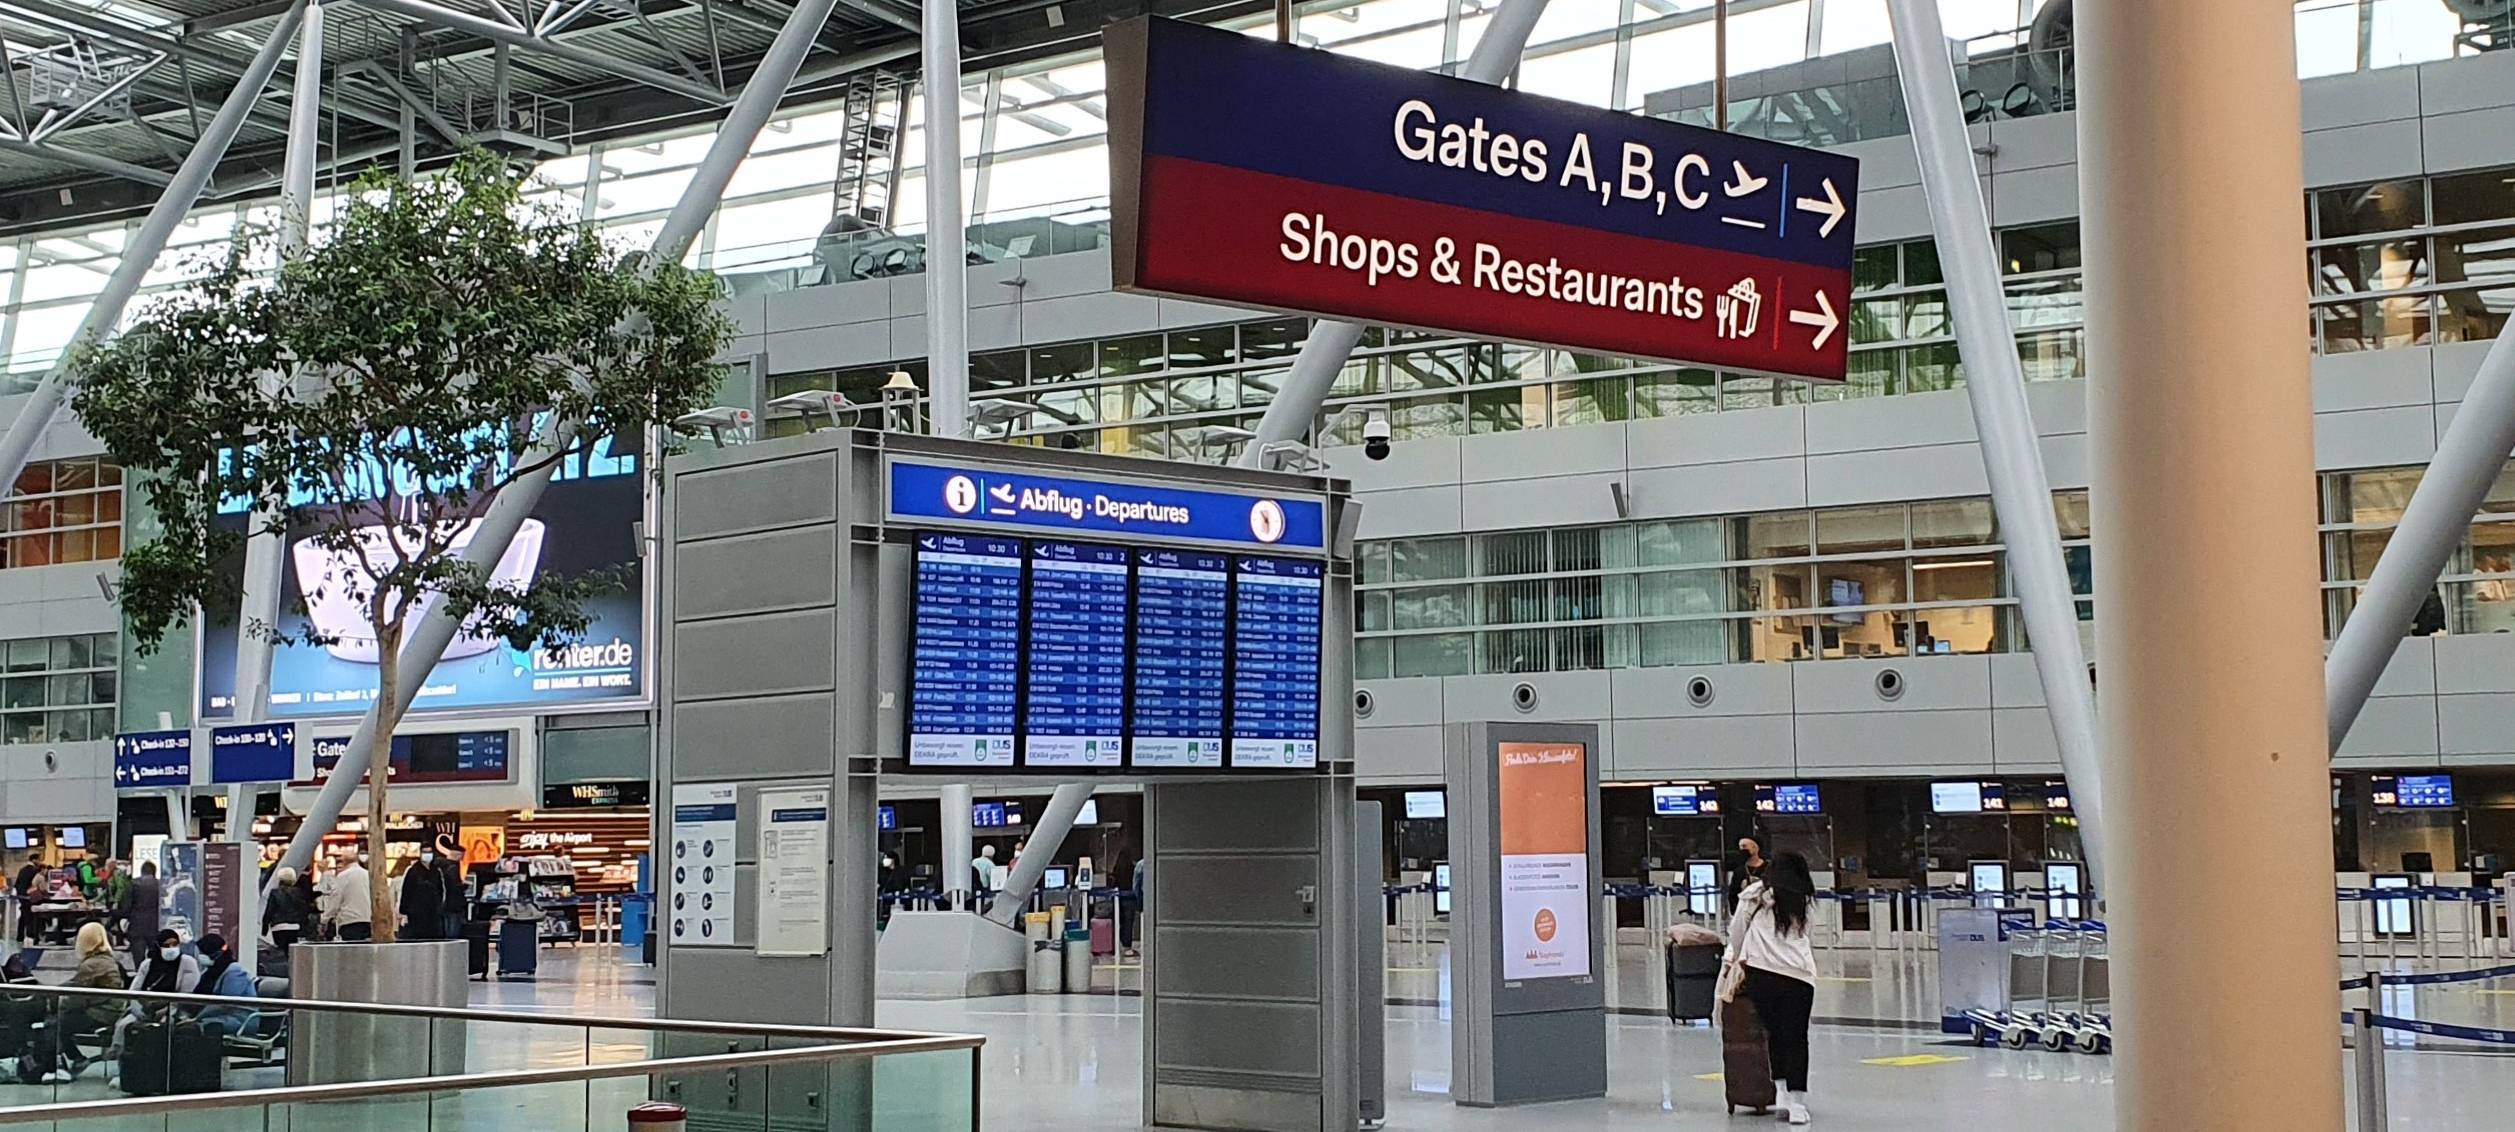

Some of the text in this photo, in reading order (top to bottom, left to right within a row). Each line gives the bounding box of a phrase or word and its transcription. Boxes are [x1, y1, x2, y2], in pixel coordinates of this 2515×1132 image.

[1395, 100, 1711, 217] Gates A,B,C
[1280, 212, 1704, 320] Shops & Restaurants
[1020, 489, 1190, 524] Abflug Departures
[943, 537, 964, 547] Abflug
[1014, 545, 1018, 554] 1
[1055, 545, 1075, 554] Abflug
[1120, 552, 1125, 561] 2
[1314, 567, 1319, 575] 4
[533, 674, 632, 690] EIN NAME. EIN WORT.
[141, 740, 164, 749] Check-in
[215, 736, 240, 744] Check-in
[992, 740, 1011, 750] DUS
[317, 741, 346, 757] Gate
[141, 767, 163, 776] Check-in
[572, 785, 619, 798] WHSmith
[1756, 799, 1775, 811] 142
[1983, 798, 2005, 809] 141
[436, 822, 456, 833] WH
[520, 830, 593, 850] enjoy the Airport
